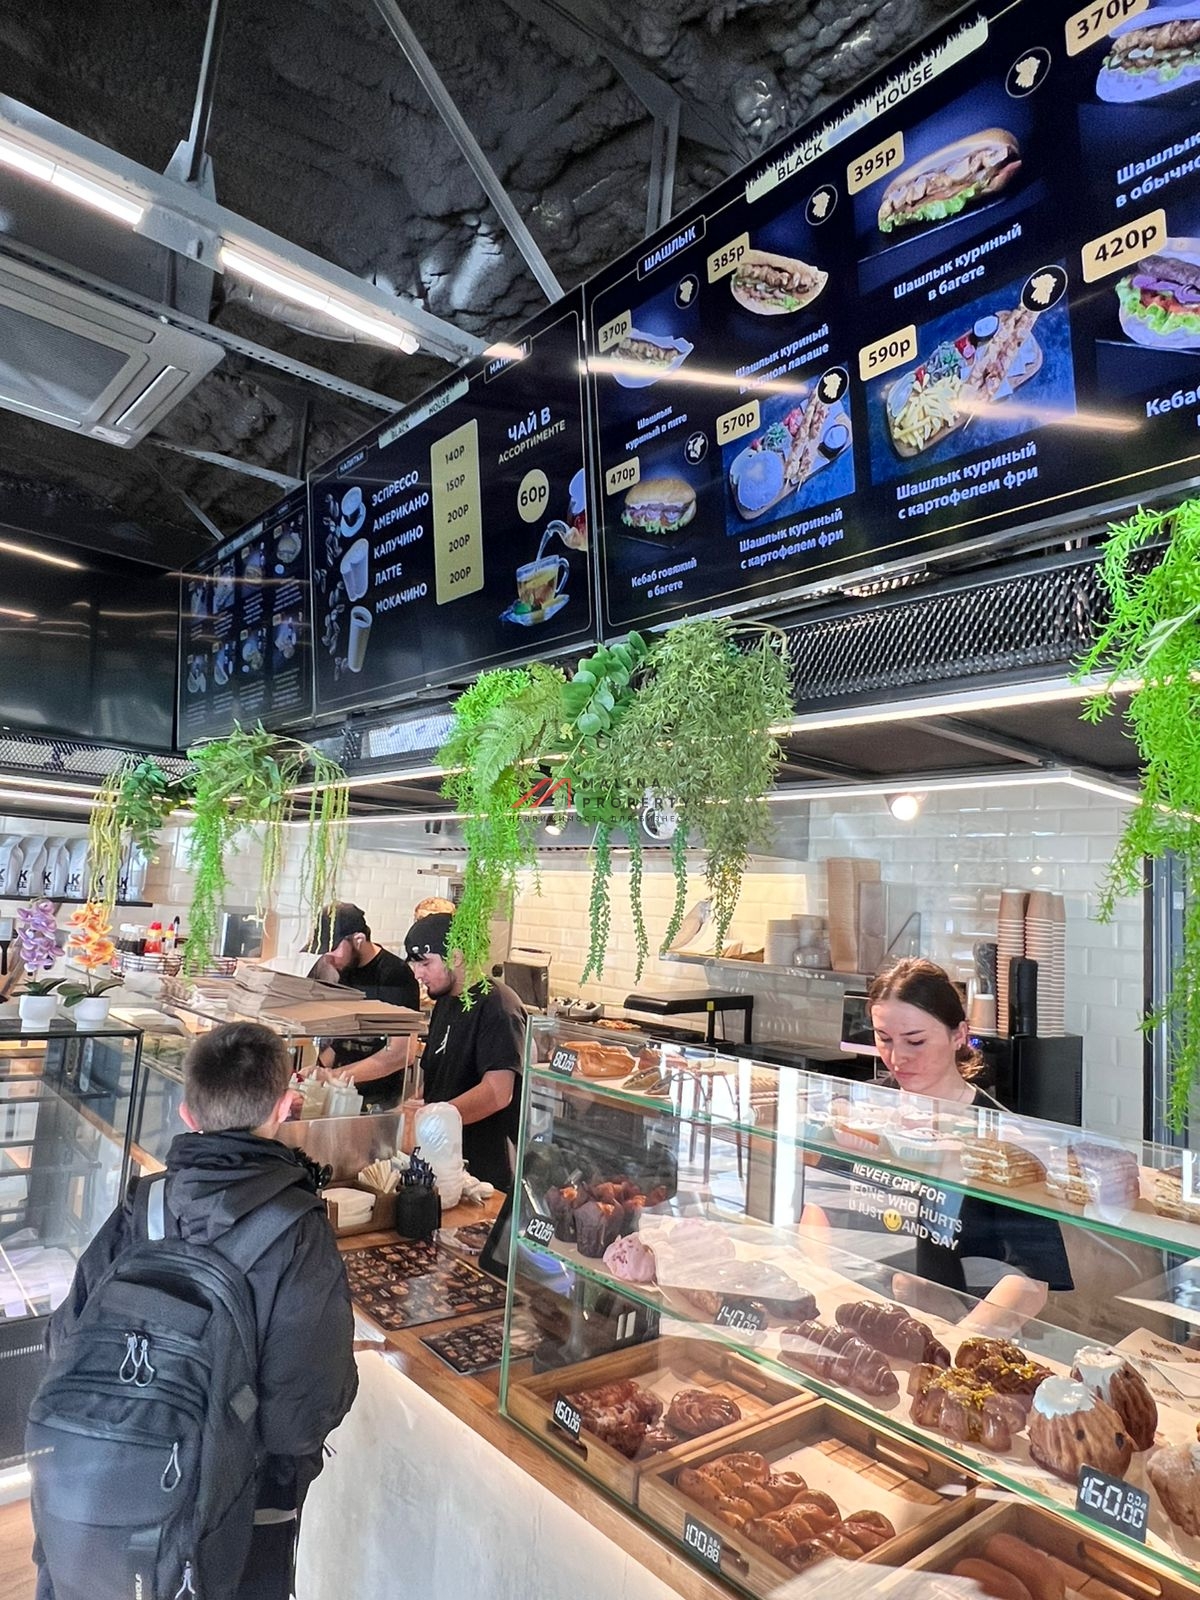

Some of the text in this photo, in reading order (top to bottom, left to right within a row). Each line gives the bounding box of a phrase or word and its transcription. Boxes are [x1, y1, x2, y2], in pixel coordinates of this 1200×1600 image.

[776, 63, 934, 181] BLACK HOUSE
[854, 147, 896, 182] 395р
[1116, 194, 1127, 208] в
[644, 225, 696, 272] ШАШЛЫК
[713, 245, 745, 273] 385р
[893, 222, 1022, 299] Шашлык куриный
[1095, 225, 1157, 263] 420р
[928, 264, 985, 301] в багете
[603, 321, 628, 342] 370р
[736, 323, 829, 377] Шашлык куриный
[788, 343, 829, 371] лаваше
[868, 338, 911, 368] 590р
[508, 406, 551, 441] ЧАЙ В
[637, 405, 673, 430] Шашлык
[723, 412, 754, 435] 570р
[498, 419, 566, 464] АССОРТИМЕНТЕ
[625, 425, 661, 451] куриный
[610, 467, 636, 485] 470р
[896, 441, 1037, 500] Шашлык куриный
[371, 470, 419, 507] ЭСПРЕССО
[520, 485, 547, 507] 60р
[898, 465, 1039, 520] с картофелем фри
[372, 492, 430, 532] АМЕРИКАНО
[447, 503, 469, 523] 200Р
[373, 524, 424, 559] КАПУЧИНО
[448, 534, 470, 552] 200Р
[739, 508, 843, 553] Шашлык куриный
[740, 529, 844, 570] с картофелем фри
[374, 563, 403, 586] ЛАТТЕ
[449, 566, 472, 584] 200Р
[631, 557, 697, 588] Кебаб говяжий
[375, 582, 428, 613] МОКАЧИНО
[647, 580, 684, 599] в багете
[852, 1163, 946, 1206] NEVER CRY FOR
[858, 1203, 884, 1221] JUST
[887, 1193, 917, 1214] WHO
[919, 1205, 963, 1233] HURTS
[901, 1220, 959, 1251] AND SAY
[1079, 1476, 1144, 1529] 160,00
